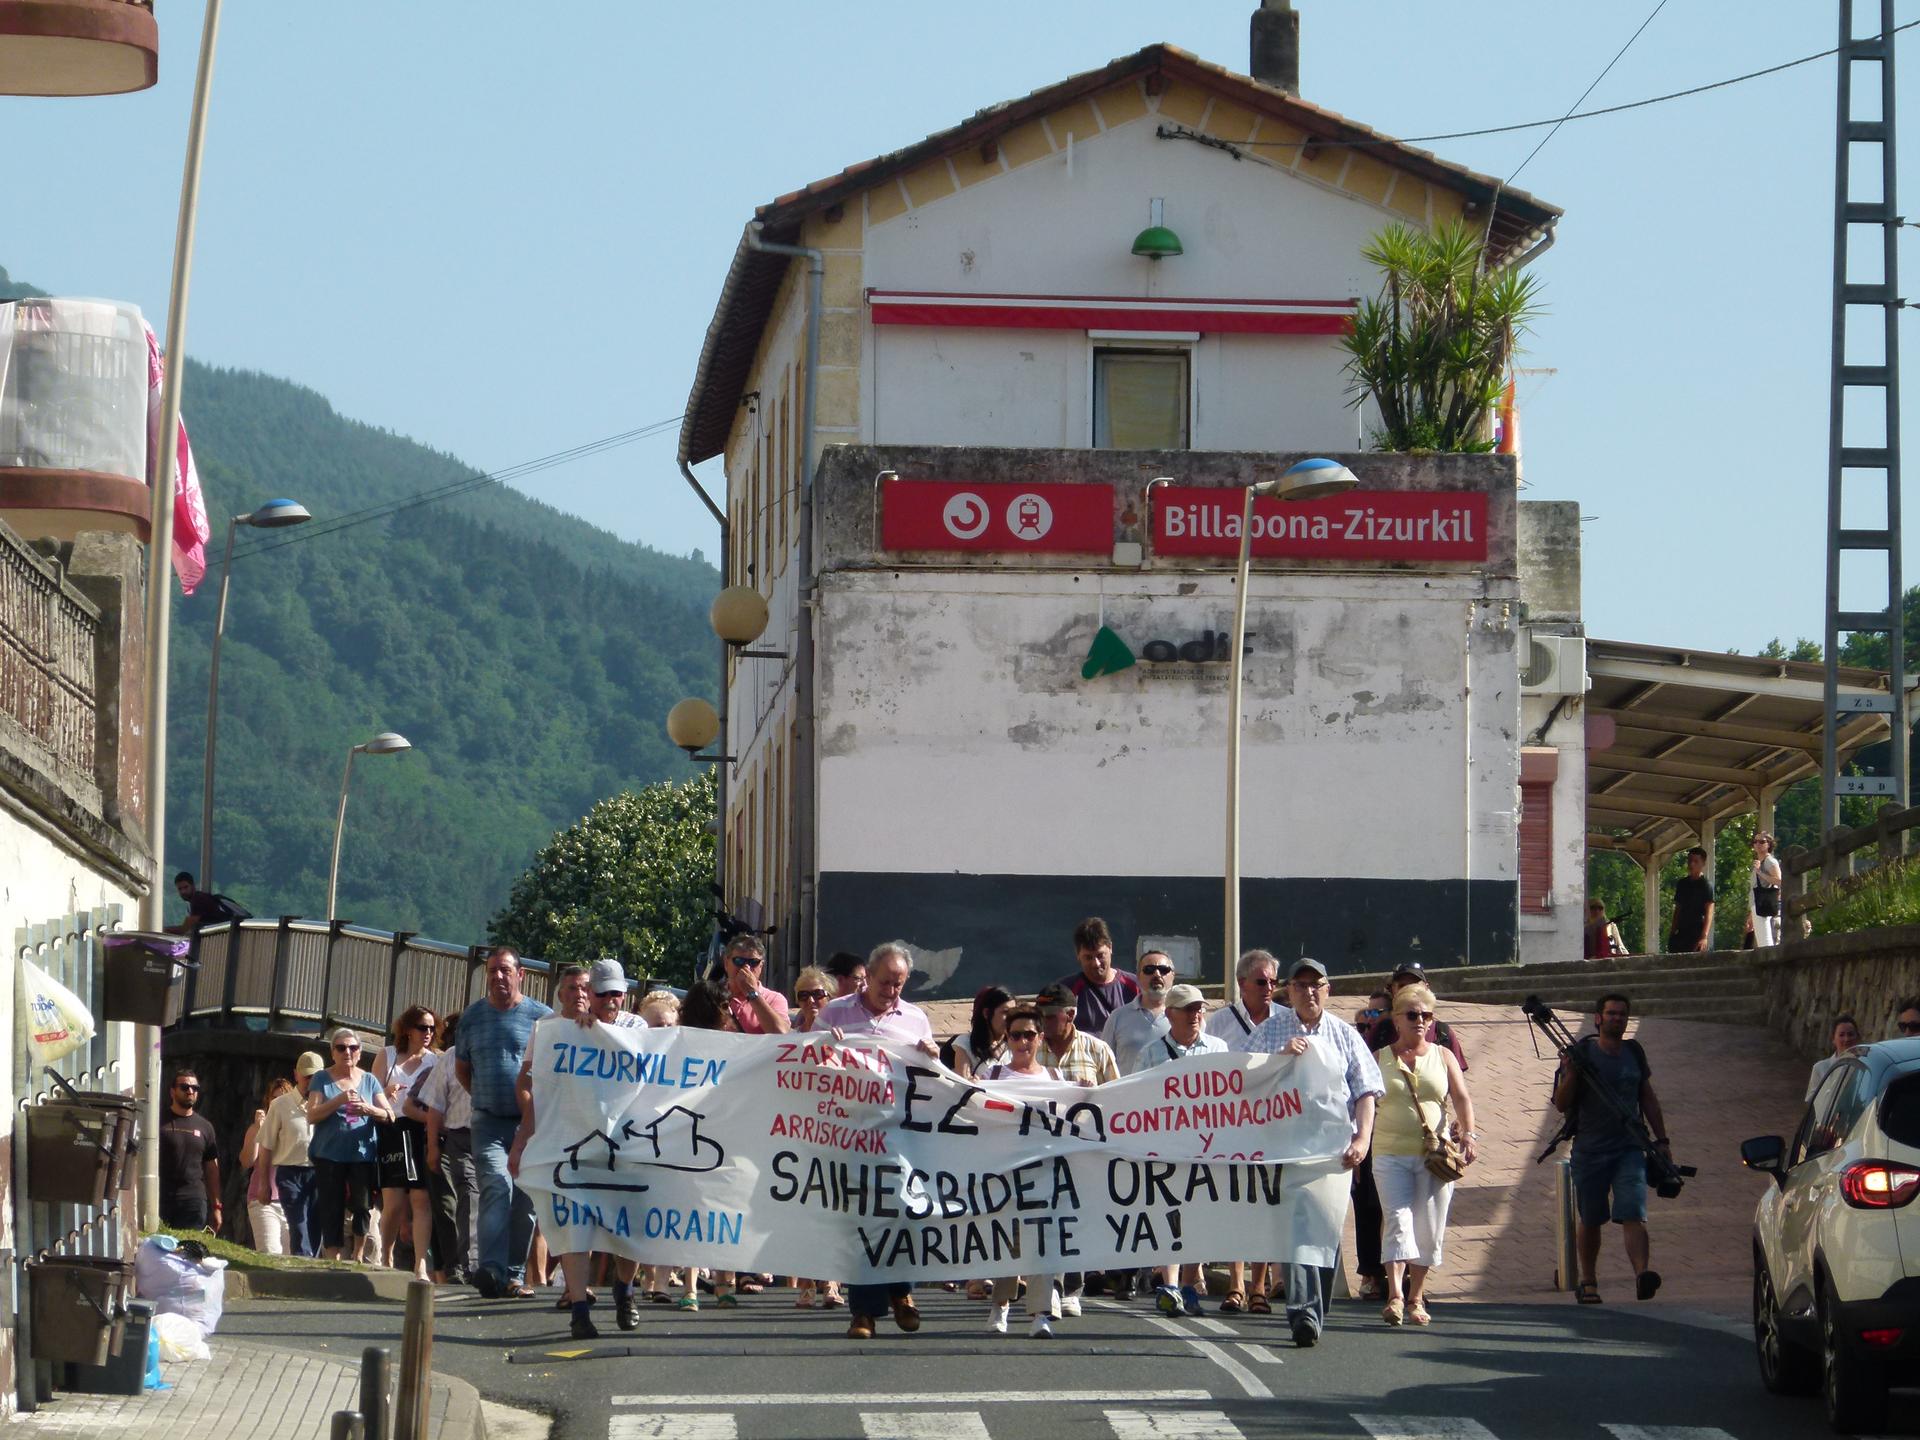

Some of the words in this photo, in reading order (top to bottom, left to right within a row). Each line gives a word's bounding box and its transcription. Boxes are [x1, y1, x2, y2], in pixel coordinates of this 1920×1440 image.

[553, 1042, 727, 1089] ZIZURKILEN
[775, 1043, 894, 1073] ZARATA
[777, 1070, 896, 1105] KUTSADURA
[1164, 1069, 1244, 1100] RUIDO
[817, 1097, 849, 1119] eta
[1109, 1088, 1303, 1135] CONTAMINACION
[770, 1113, 887, 1154] ARRISKURIK
[1199, 1132, 1214, 1153] Y
[769, 1150, 1082, 1220] SAIHESBIDEA
[1107, 1157, 1283, 1207] ORAIN
[644, 1206, 743, 1245] ORAIN
[857, 1216, 1081, 1268] VARIANTE
[1105, 1208, 1183, 1253] YA!
